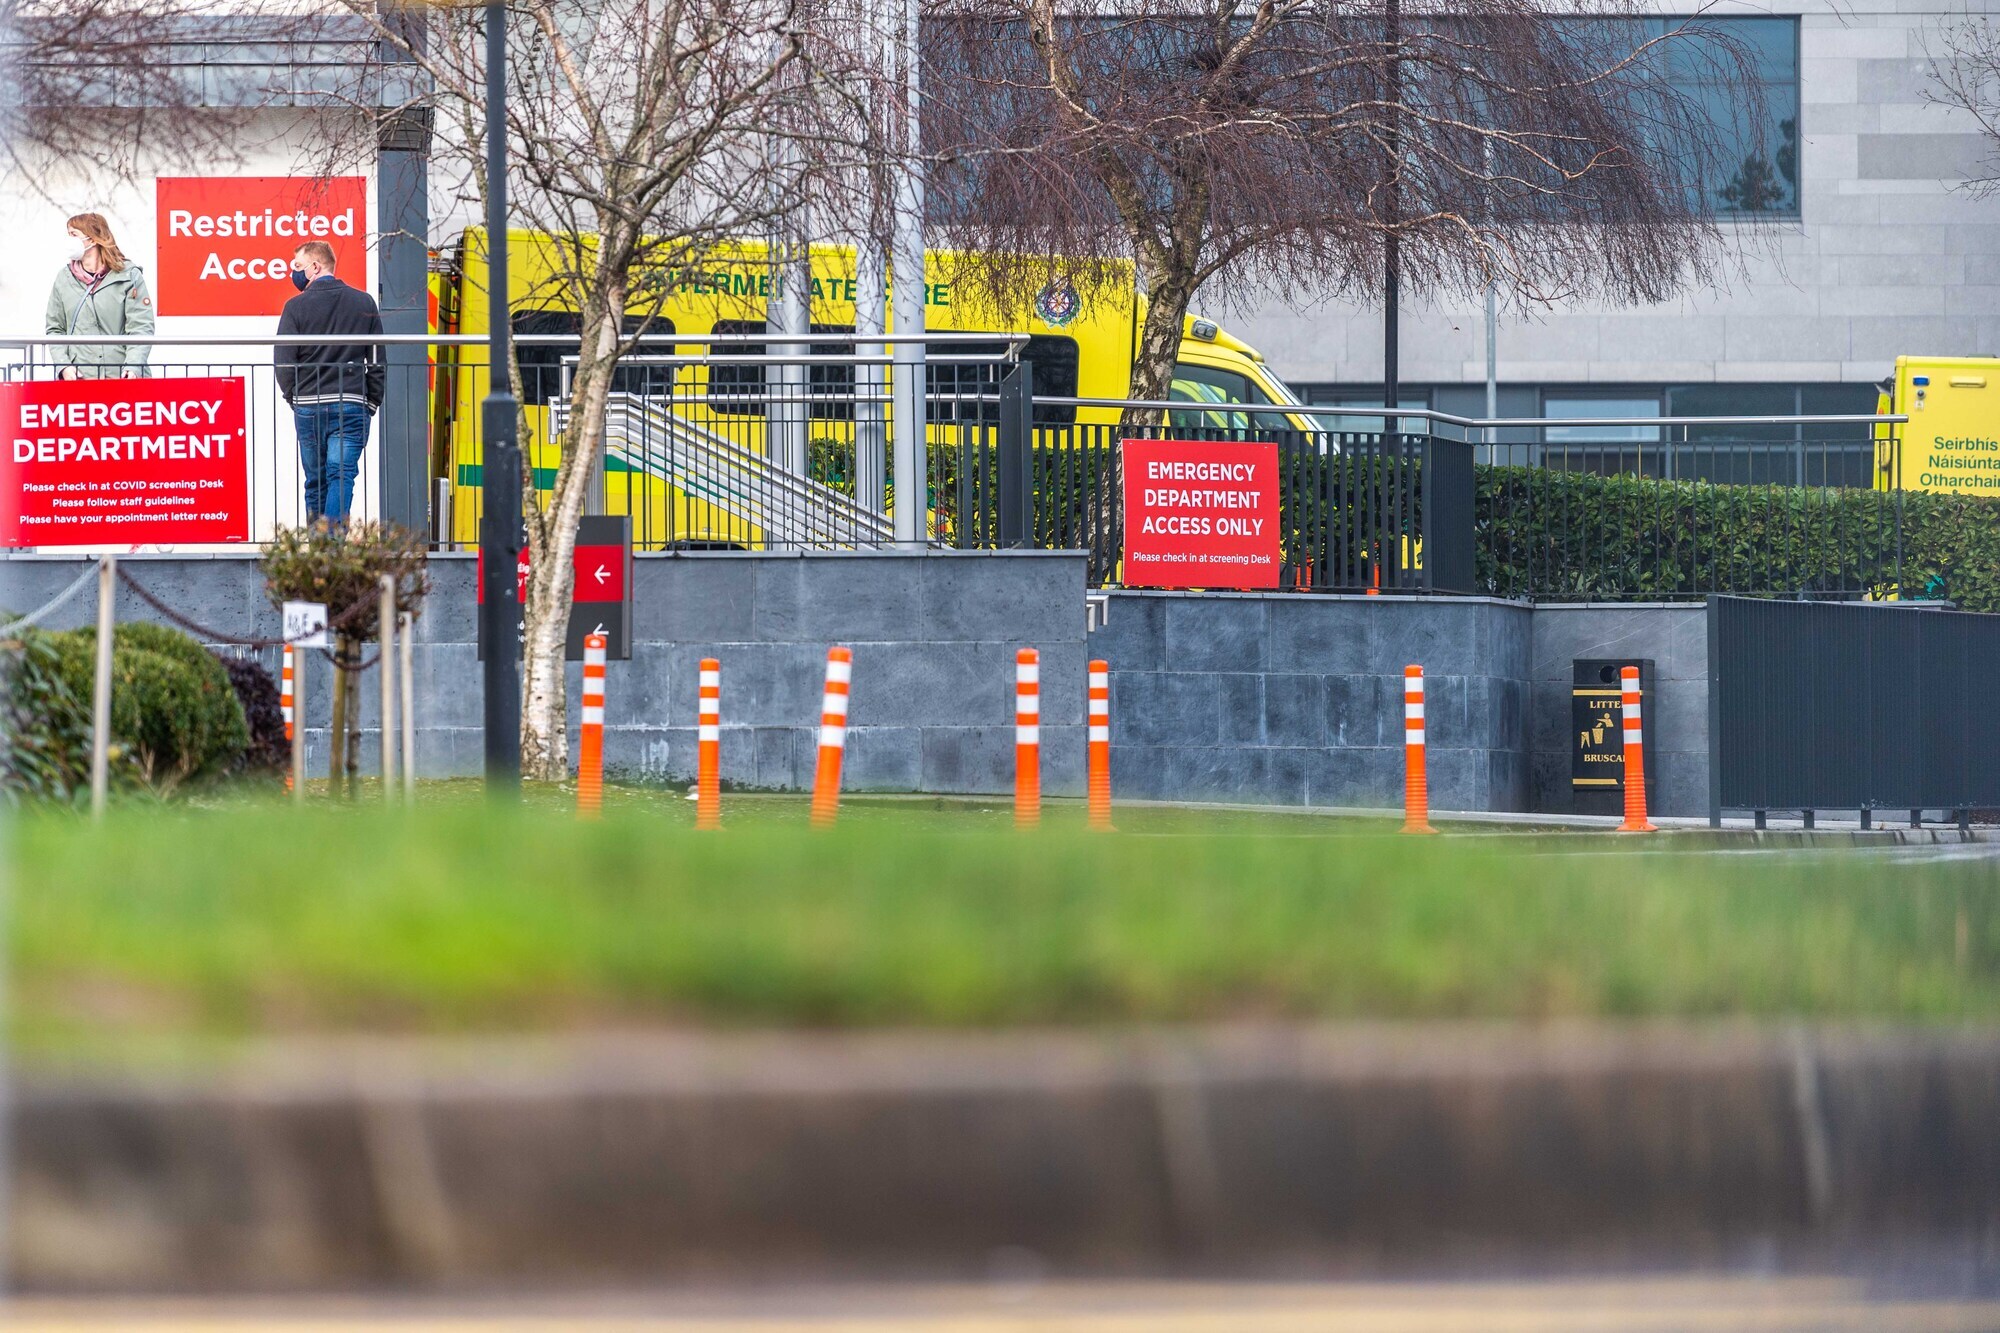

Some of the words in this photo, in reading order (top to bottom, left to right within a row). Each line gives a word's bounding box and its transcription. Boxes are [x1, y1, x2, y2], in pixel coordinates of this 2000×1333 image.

[169, 208, 354, 237] Restricted
[199, 252, 295, 280] Acce
[20, 400, 223, 429] EMERGENCY
[13, 434, 231, 463] DEPARTMENT
[1934, 436, 1999, 451] Seirbhís
[1928, 454, 2000, 469] Náisiúnta
[1148, 462, 1256, 481] EMERGENCY
[23, 483, 55, 492] Please
[57, 482, 86, 491] check
[89, 482, 98, 491] in
[100, 482, 110, 490] at
[113, 481, 147, 490] COVID
[149, 480, 197, 490] screening
[199, 479, 224, 488] Desk
[52, 498, 84, 507] Please
[87, 497, 118, 506] follow
[120, 497, 143, 506] staff
[145, 496, 195, 507] guidelines
[1144, 489, 1261, 508] DEPARTMENT
[19, 515, 51, 524] Please
[54, 514, 78, 523] have
[80, 515, 103, 525] your
[105, 513, 169, 523] appointment
[171, 512, 198, 521] letter
[200, 511, 229, 521] ready
[1142, 516, 1211, 535] ACCESS
[1216, 518, 1263, 536] ONLY
[1133, 552, 1160, 562] Please
[1162, 553, 1187, 562] check
[1189, 553, 1197, 562] in
[1199, 554, 1208, 562] at
[1209, 554, 1249, 565] screening
[1251, 554, 1271, 564] Desk
[1590, 700, 1622, 709] LITTE
[1584, 754, 1625, 762] BRUSCA
